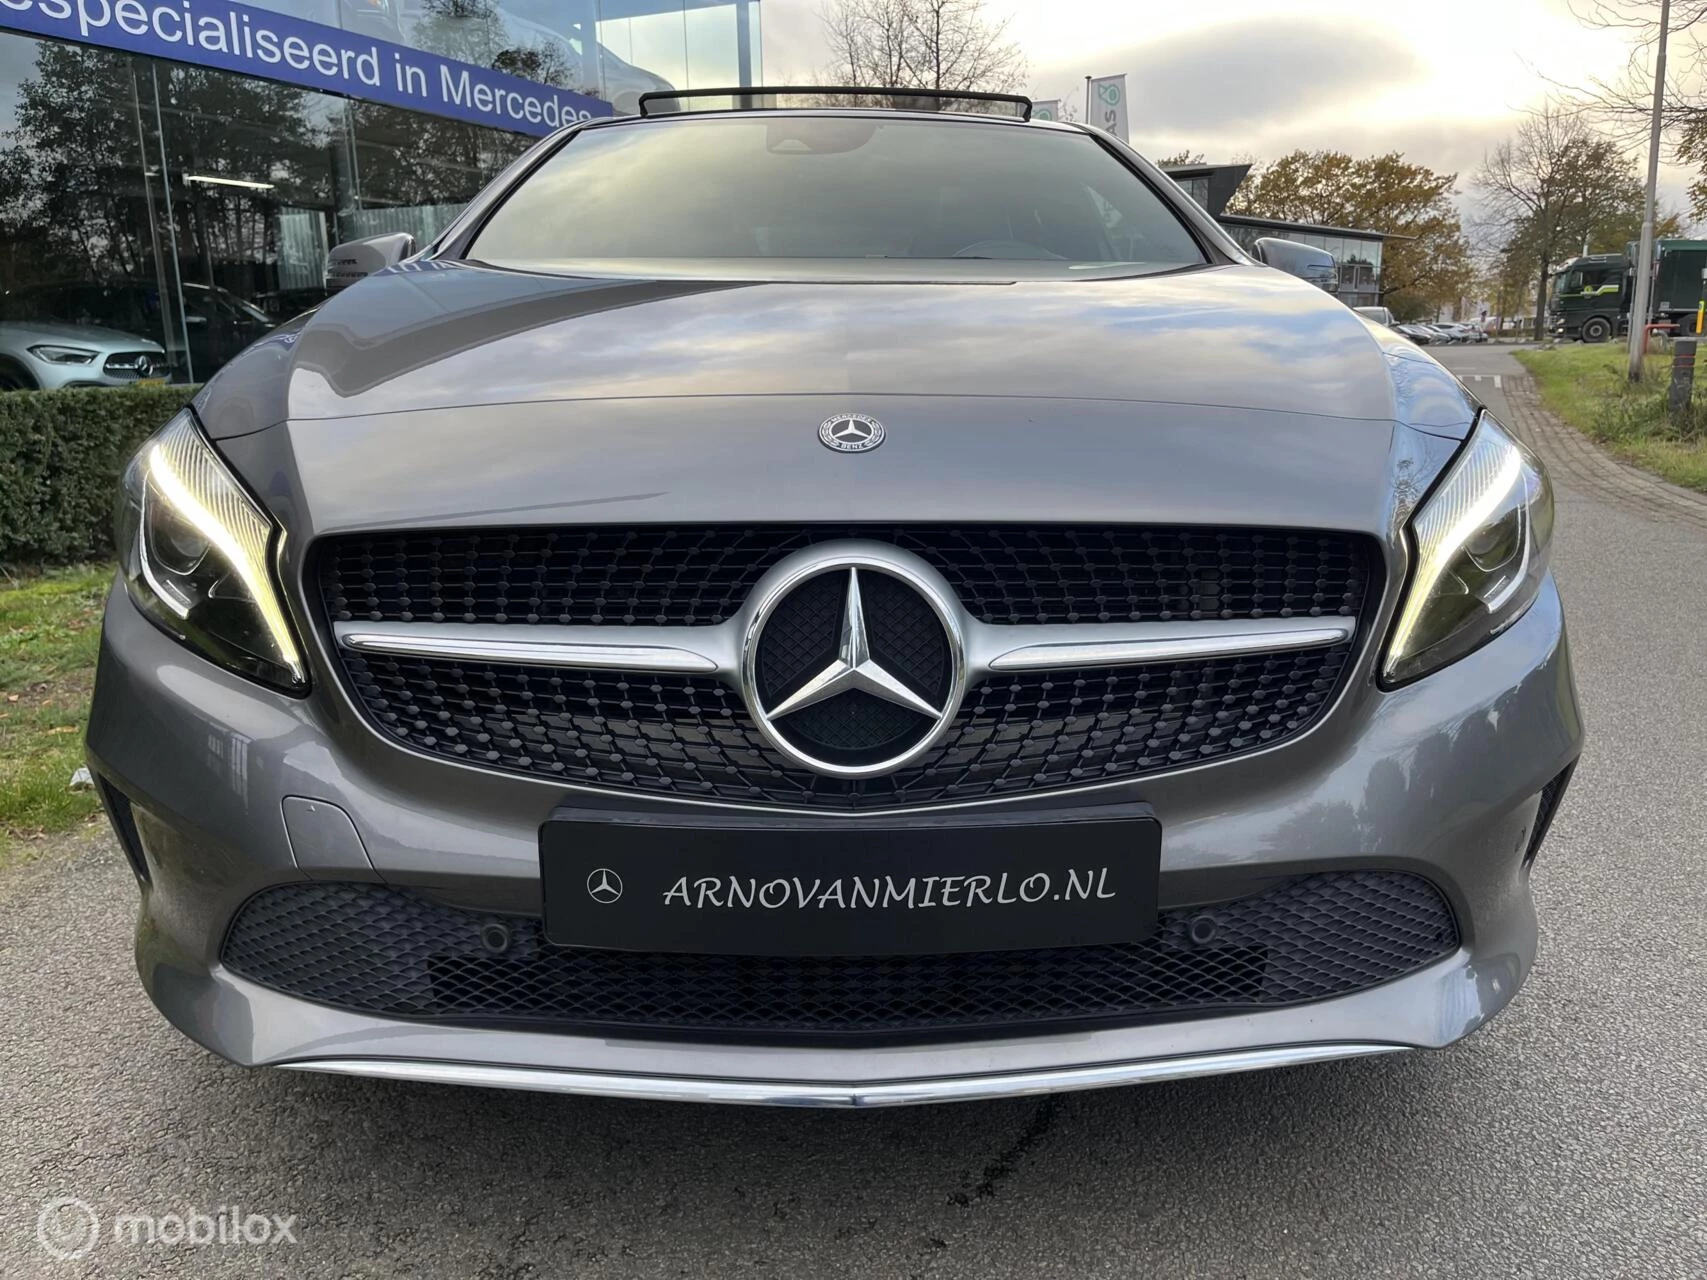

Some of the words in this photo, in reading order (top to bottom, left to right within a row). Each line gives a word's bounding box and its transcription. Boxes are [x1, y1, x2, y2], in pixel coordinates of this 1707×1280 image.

[0, 0, 380, 87] specialiseerd
[394, 52, 427, 97] in
[662, 867, 1116, 909] ARNOVANMIERLO.NL
